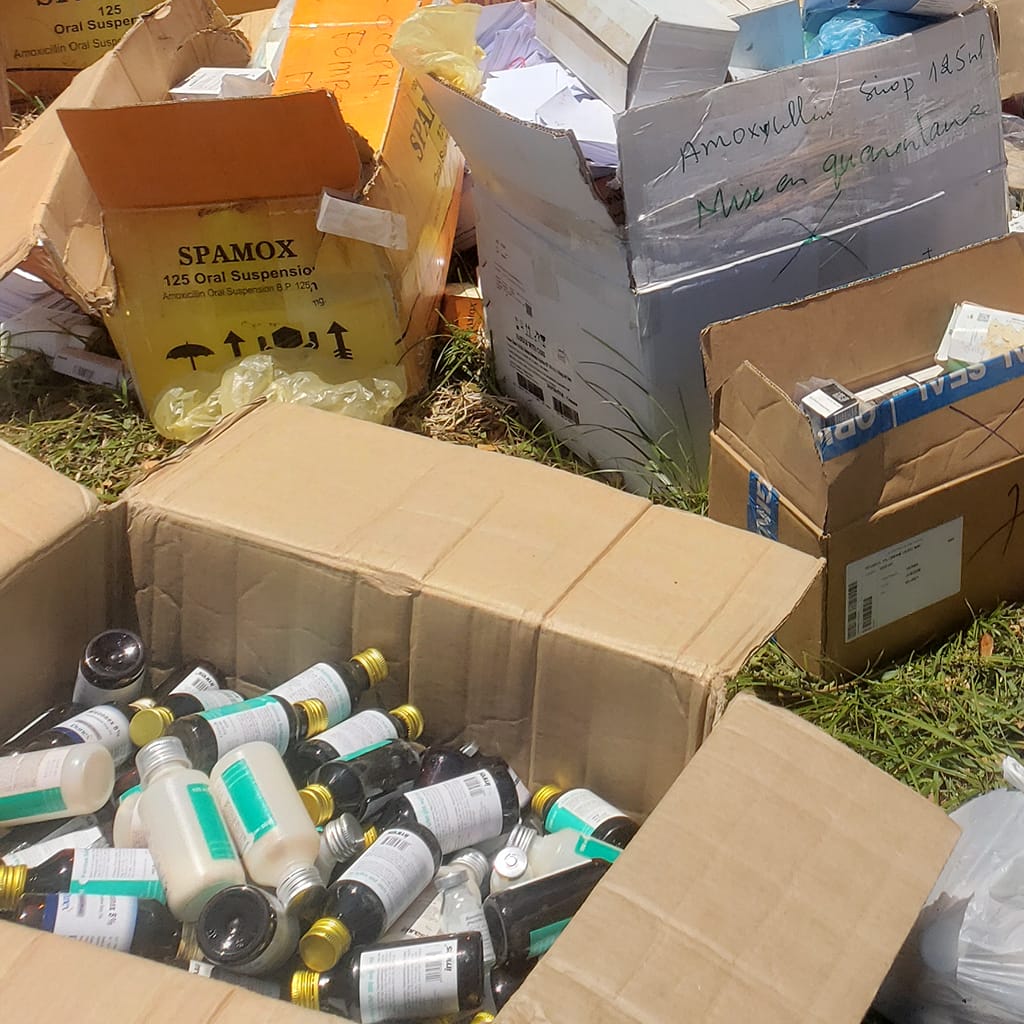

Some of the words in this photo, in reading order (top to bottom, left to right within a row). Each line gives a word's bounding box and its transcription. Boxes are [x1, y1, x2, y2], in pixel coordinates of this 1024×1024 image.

[98, 4, 123, 18] 125
[54, 21, 83, 36] Oral
[14, 44, 68, 60] Amoxicillin
[69, 38, 91, 53] Oral
[776, 173, 808, 195] en
[178, 238, 299, 267] SPAMOX
[163, 273, 190, 287] 125
[194, 271, 227, 286] Oral
[207, 288, 225, 298] Oral
[226, 285, 275, 297] Suspension
[918, 362, 987, 401] SEAL
